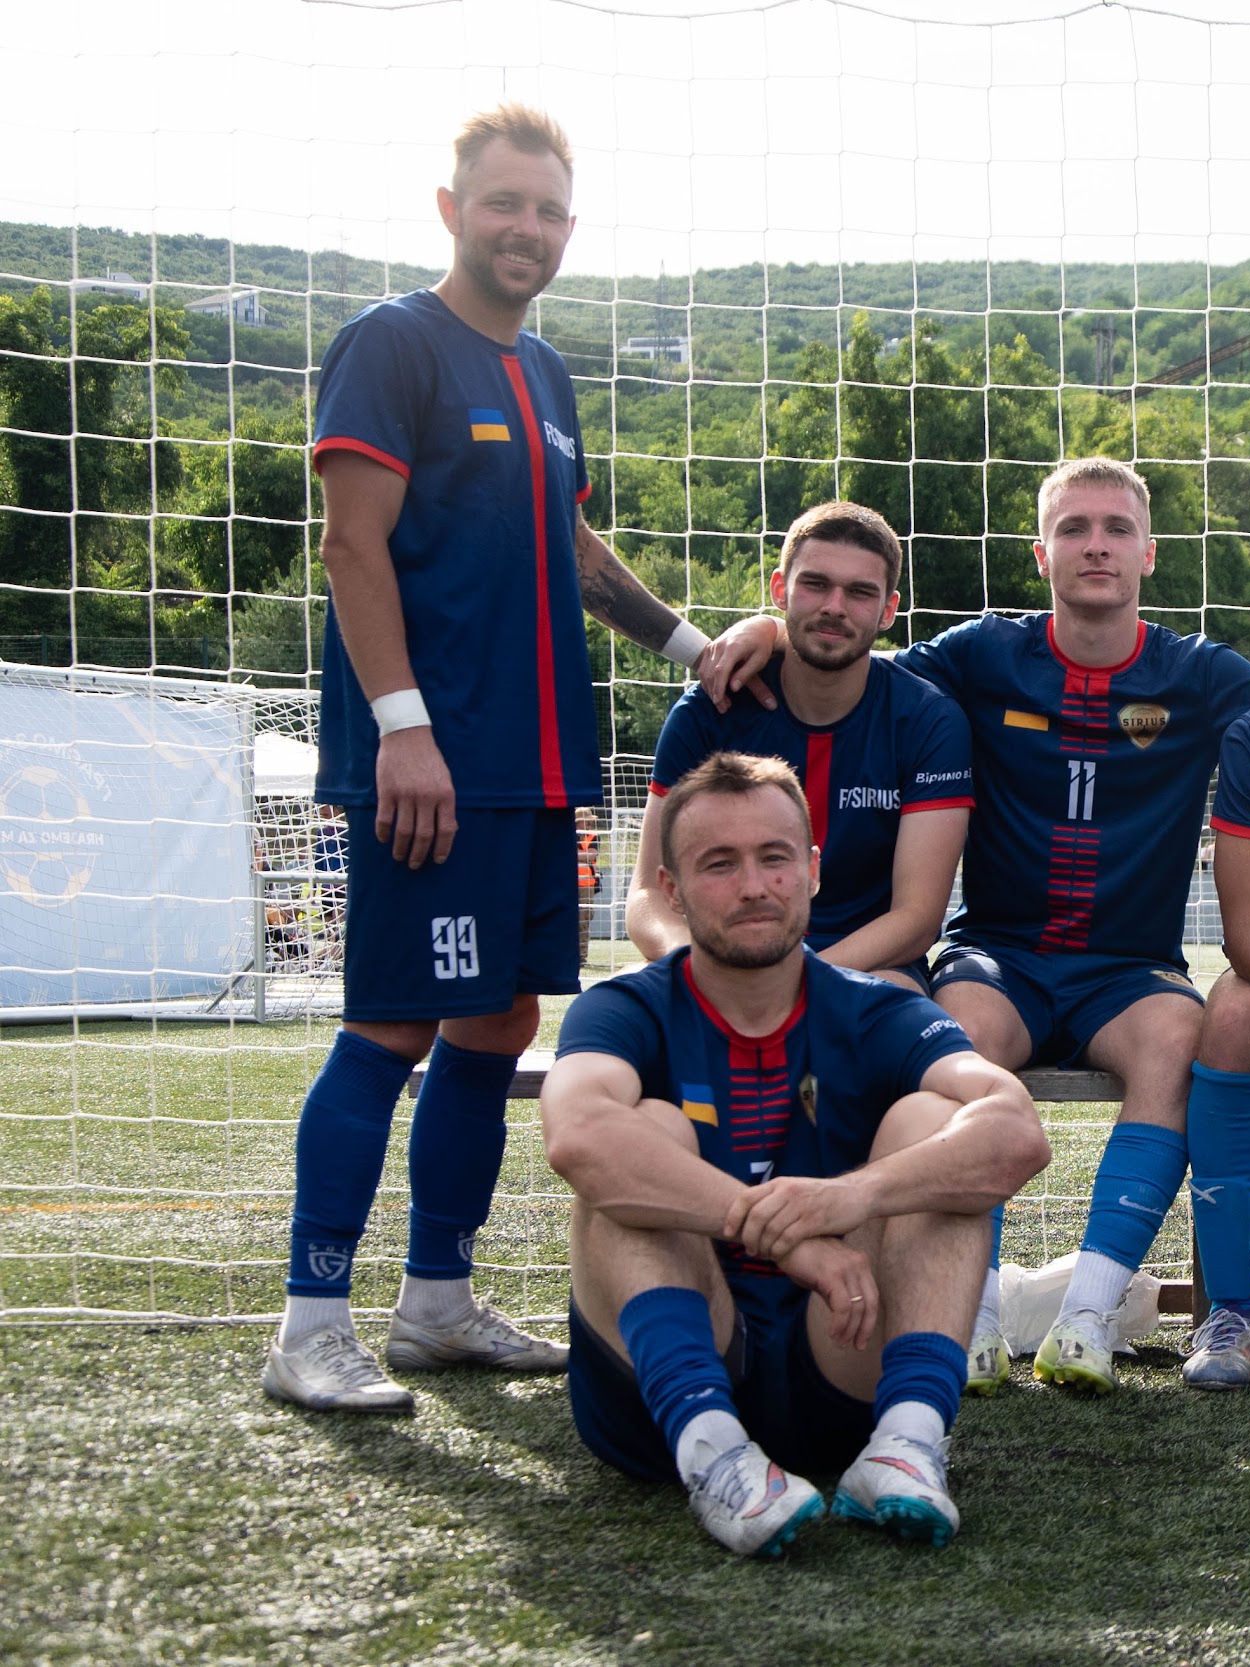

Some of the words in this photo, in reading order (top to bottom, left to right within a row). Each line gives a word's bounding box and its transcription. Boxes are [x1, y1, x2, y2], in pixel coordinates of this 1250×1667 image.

[1122, 717, 1166, 728] SIRIUS
[1067, 759, 1097, 821] 11
[431, 915, 480, 980] 99
